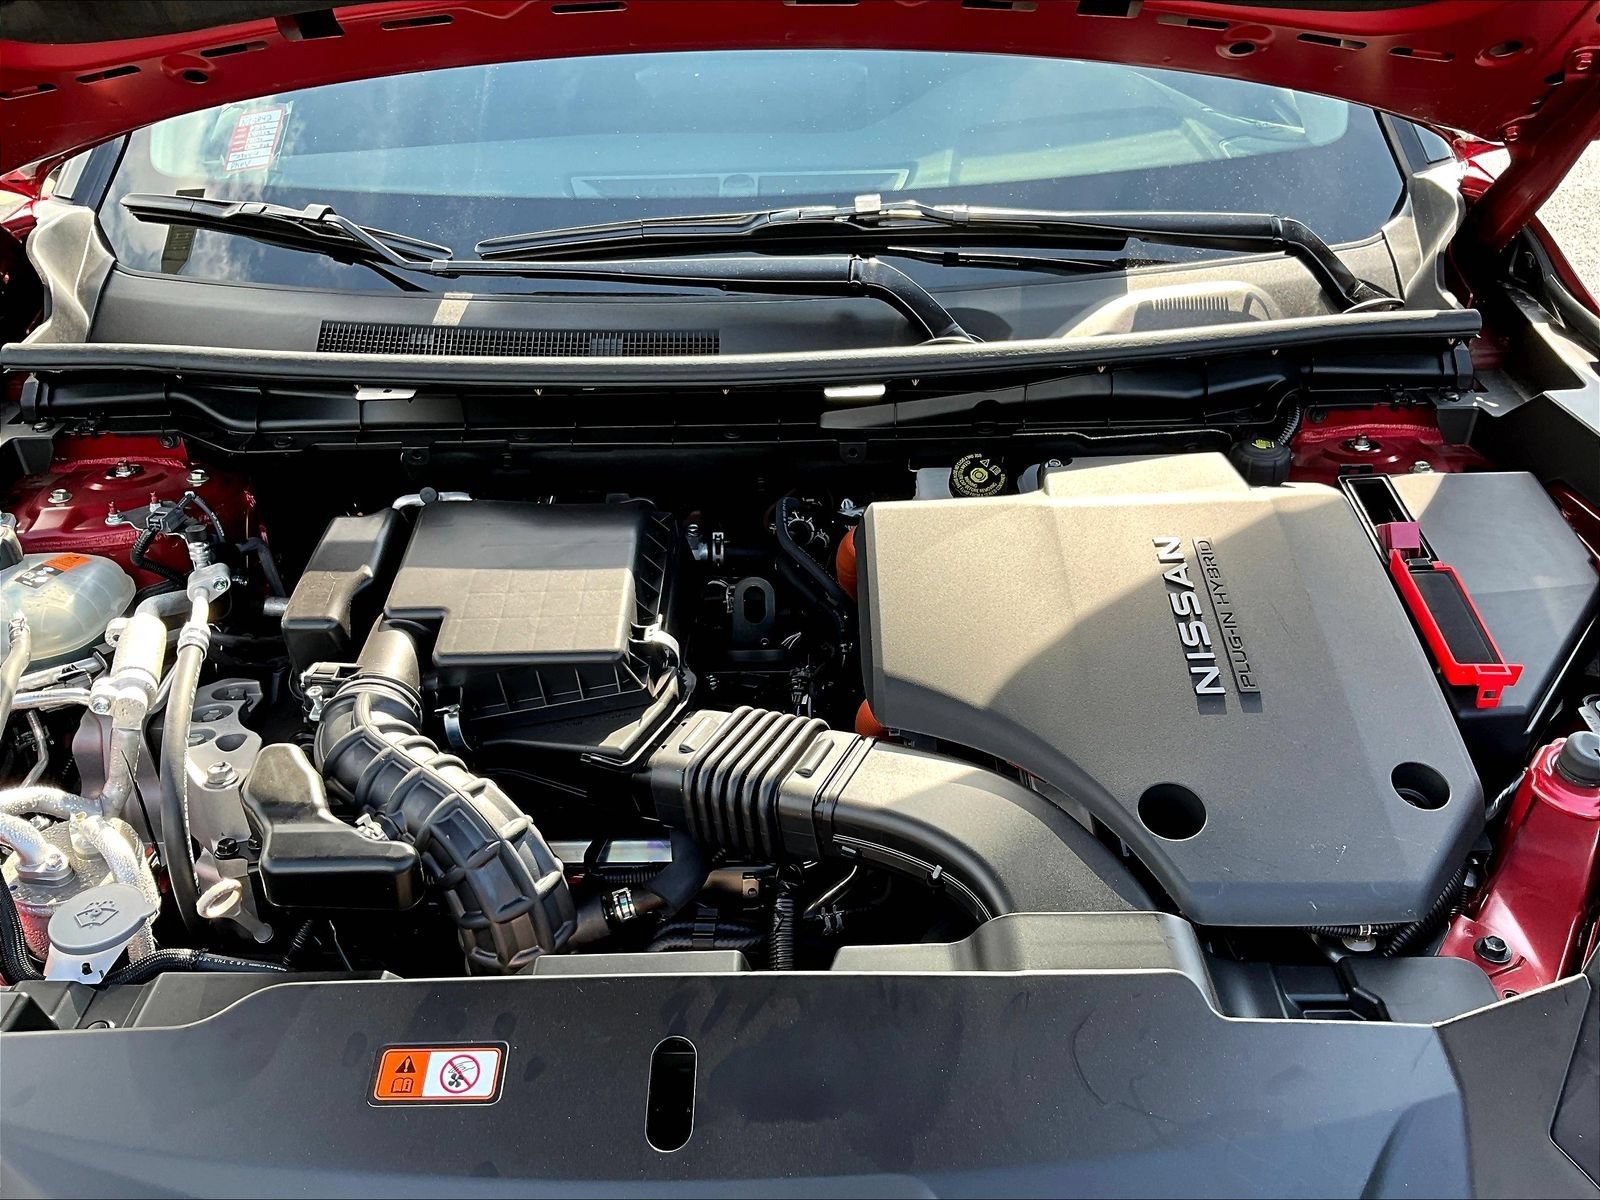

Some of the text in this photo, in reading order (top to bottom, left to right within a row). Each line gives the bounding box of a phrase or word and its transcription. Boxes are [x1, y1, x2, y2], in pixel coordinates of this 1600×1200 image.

[980, 482, 997, 492] REMOVING
[1153, 535, 1226, 694] NISSAN
[1198, 540, 1257, 689] PLUG-IN HYBRID
